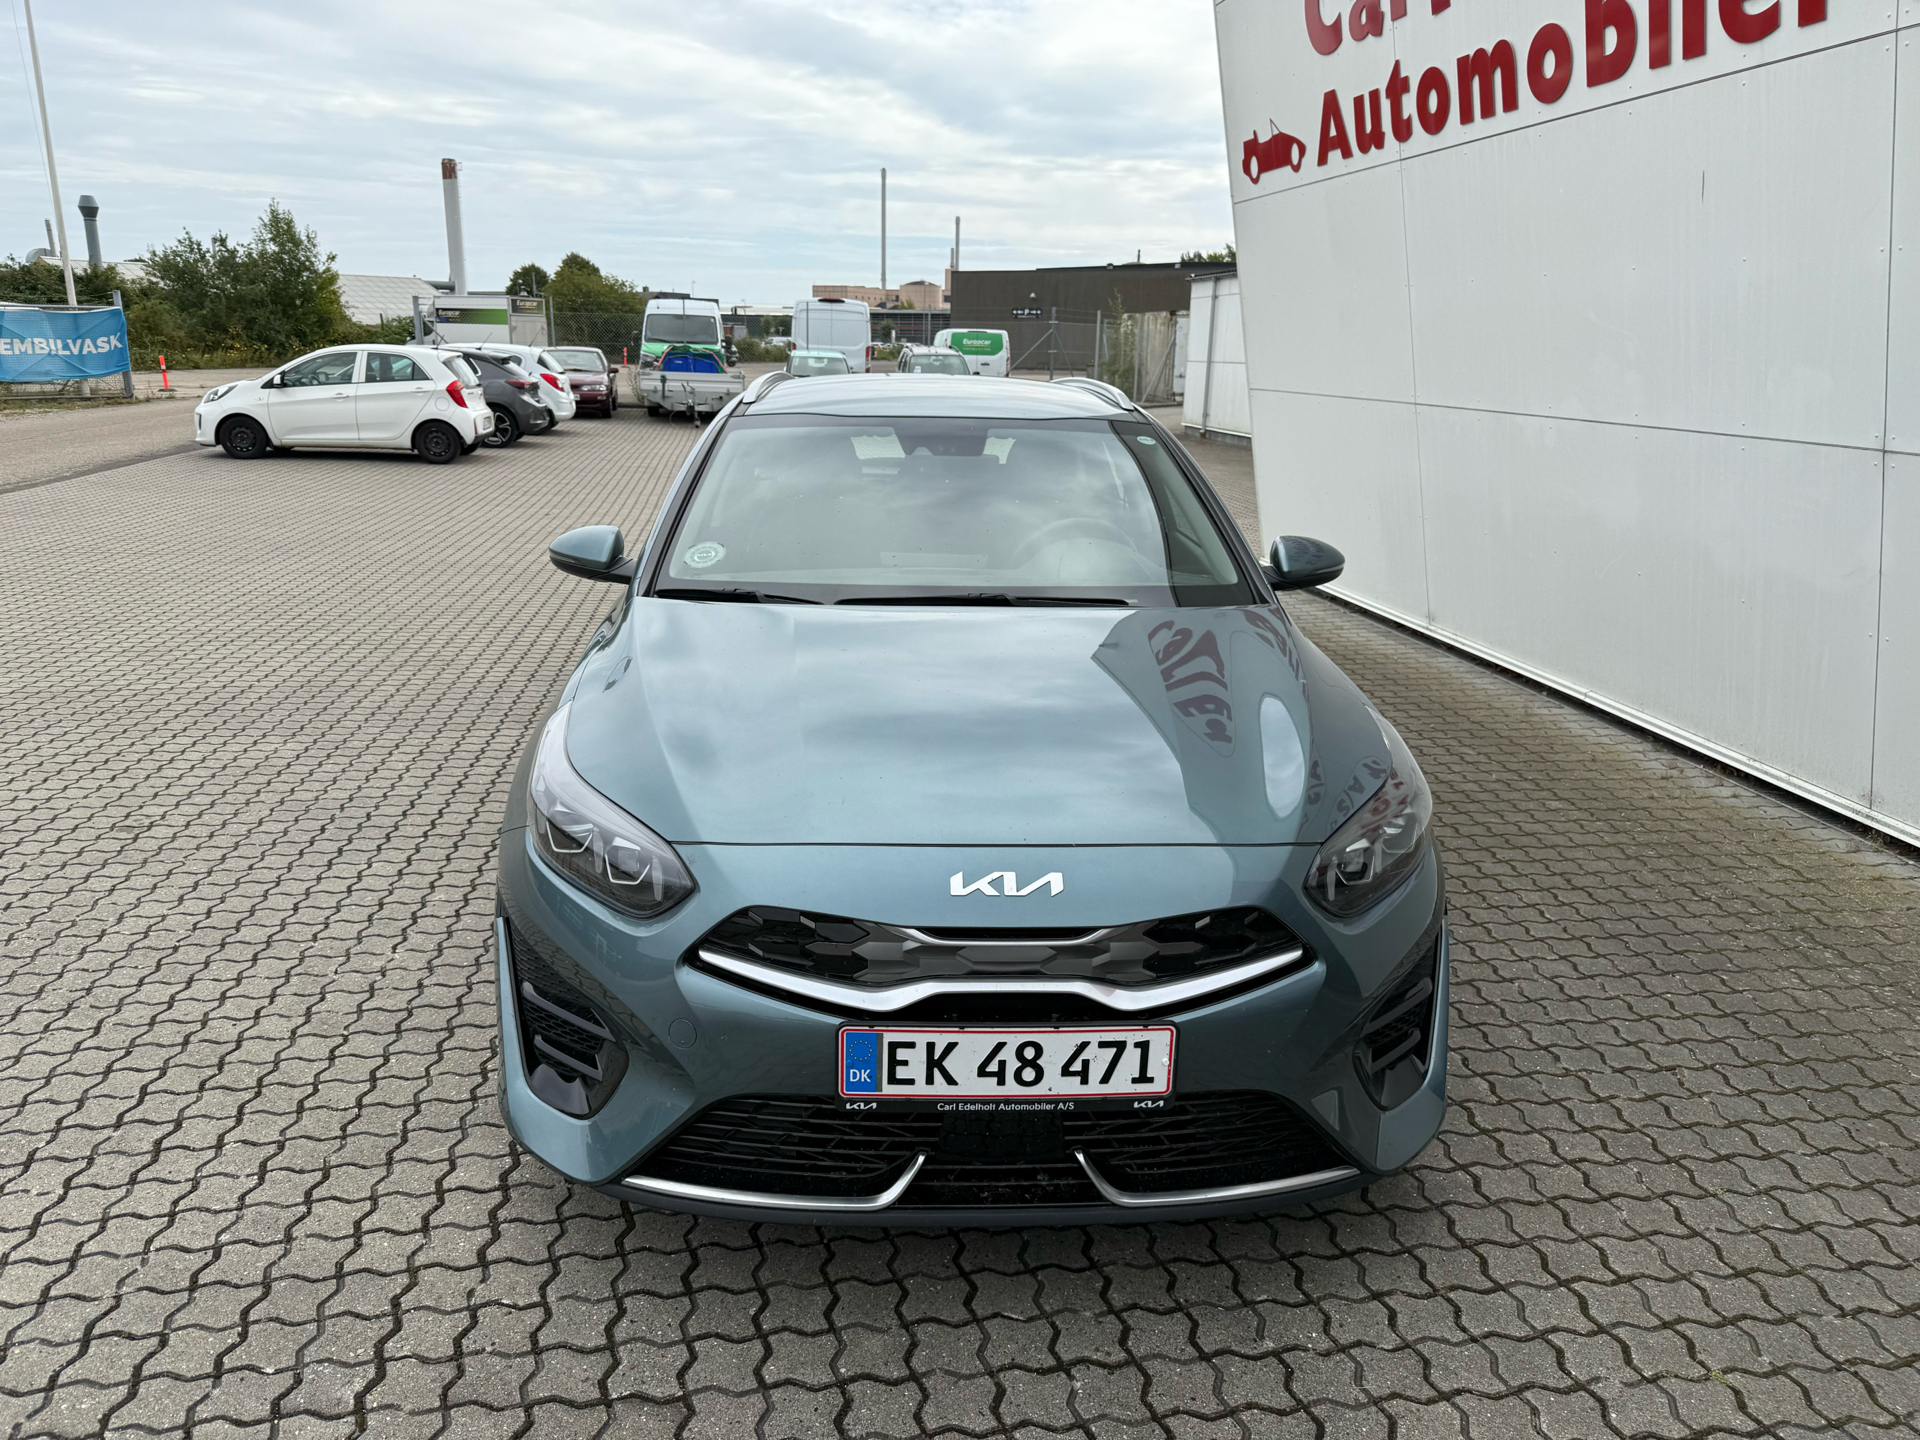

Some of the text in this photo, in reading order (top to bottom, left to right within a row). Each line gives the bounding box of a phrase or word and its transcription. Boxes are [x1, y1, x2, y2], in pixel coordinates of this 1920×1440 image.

[1305, 0, 1451, 56] Ca
[1317, 0, 1827, 167] Automobi
[0, 332, 124, 355] EMBILVASK
[950, 871, 1064, 897] KIA
[849, 1069, 871, 1082] DK
[887, 1040, 1155, 1087] EK 48 471
[937, 1103, 956, 1111] Carl
[998, 1102, 1055, 1111] Automobiler
[1057, 1102, 1075, 1110] A/S
